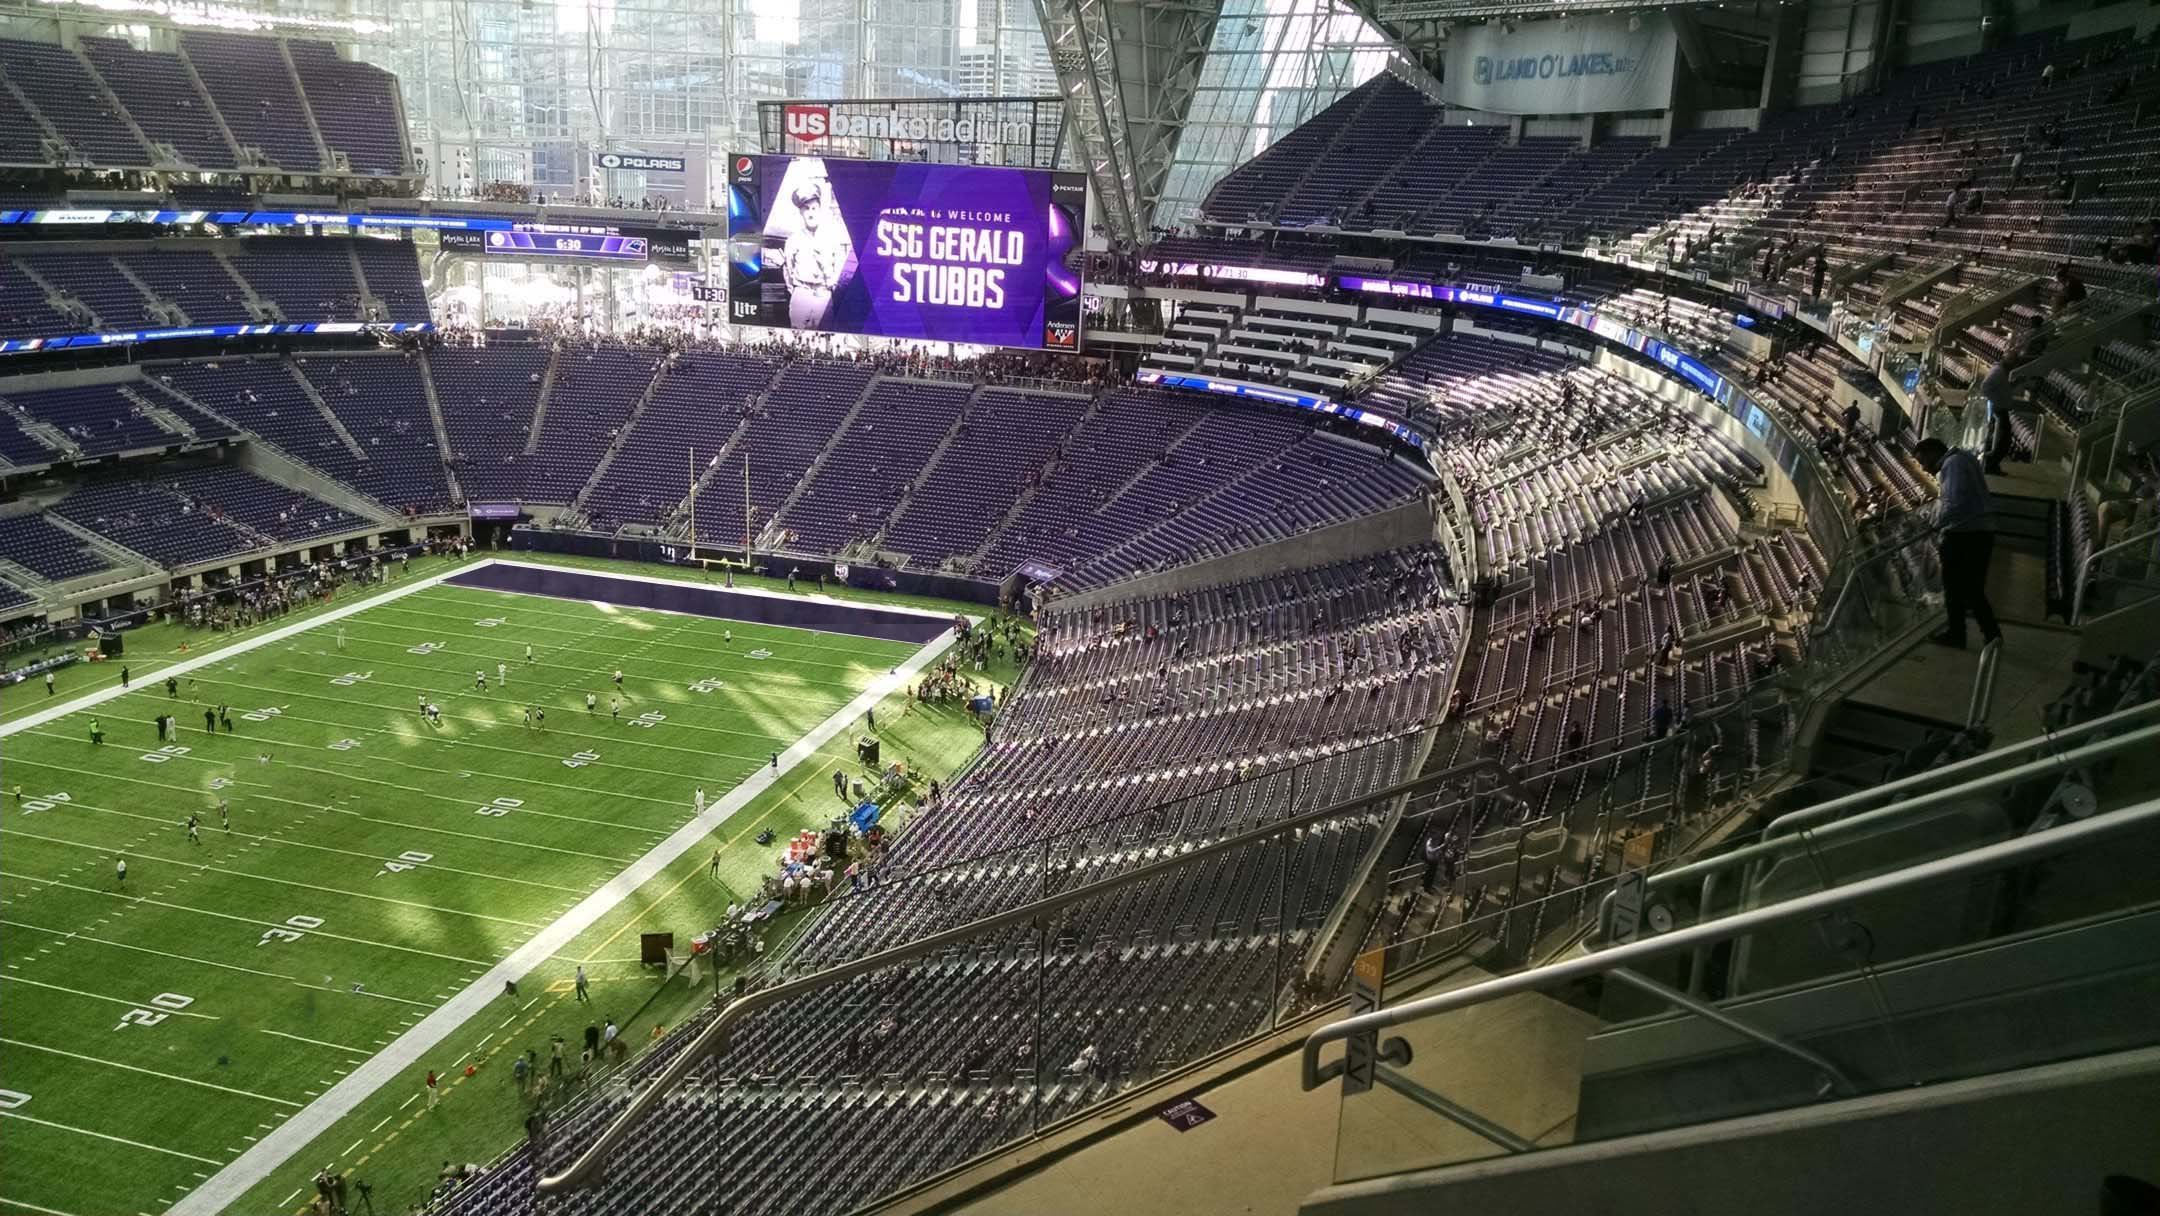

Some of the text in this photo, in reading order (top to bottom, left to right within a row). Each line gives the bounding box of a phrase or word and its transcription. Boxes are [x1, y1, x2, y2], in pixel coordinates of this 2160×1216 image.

[1496, 57, 1537, 80] LAND
[623, 158, 682, 170] POLARIS
[948, 210, 1011, 223] WELCOME
[556, 239, 581, 251] 6:30
[877, 219, 1024, 265] SSG GERALD
[893, 262, 1005, 309] STUBBS
[734, 301, 757, 318] Lite
[1084, 297, 1100, 311] 40
[1047, 320, 1075, 329] Andersen
[628, 712, 667, 728] 30
[139, 745, 193, 763] 50
[561, 752, 601, 769] 40
[20, 791, 72, 811] 40
[475, 797, 525, 817] 50
[384, 851, 434, 873] 40
[262, 914, 326, 944] 30
[120, 992, 195, 1027] 20
